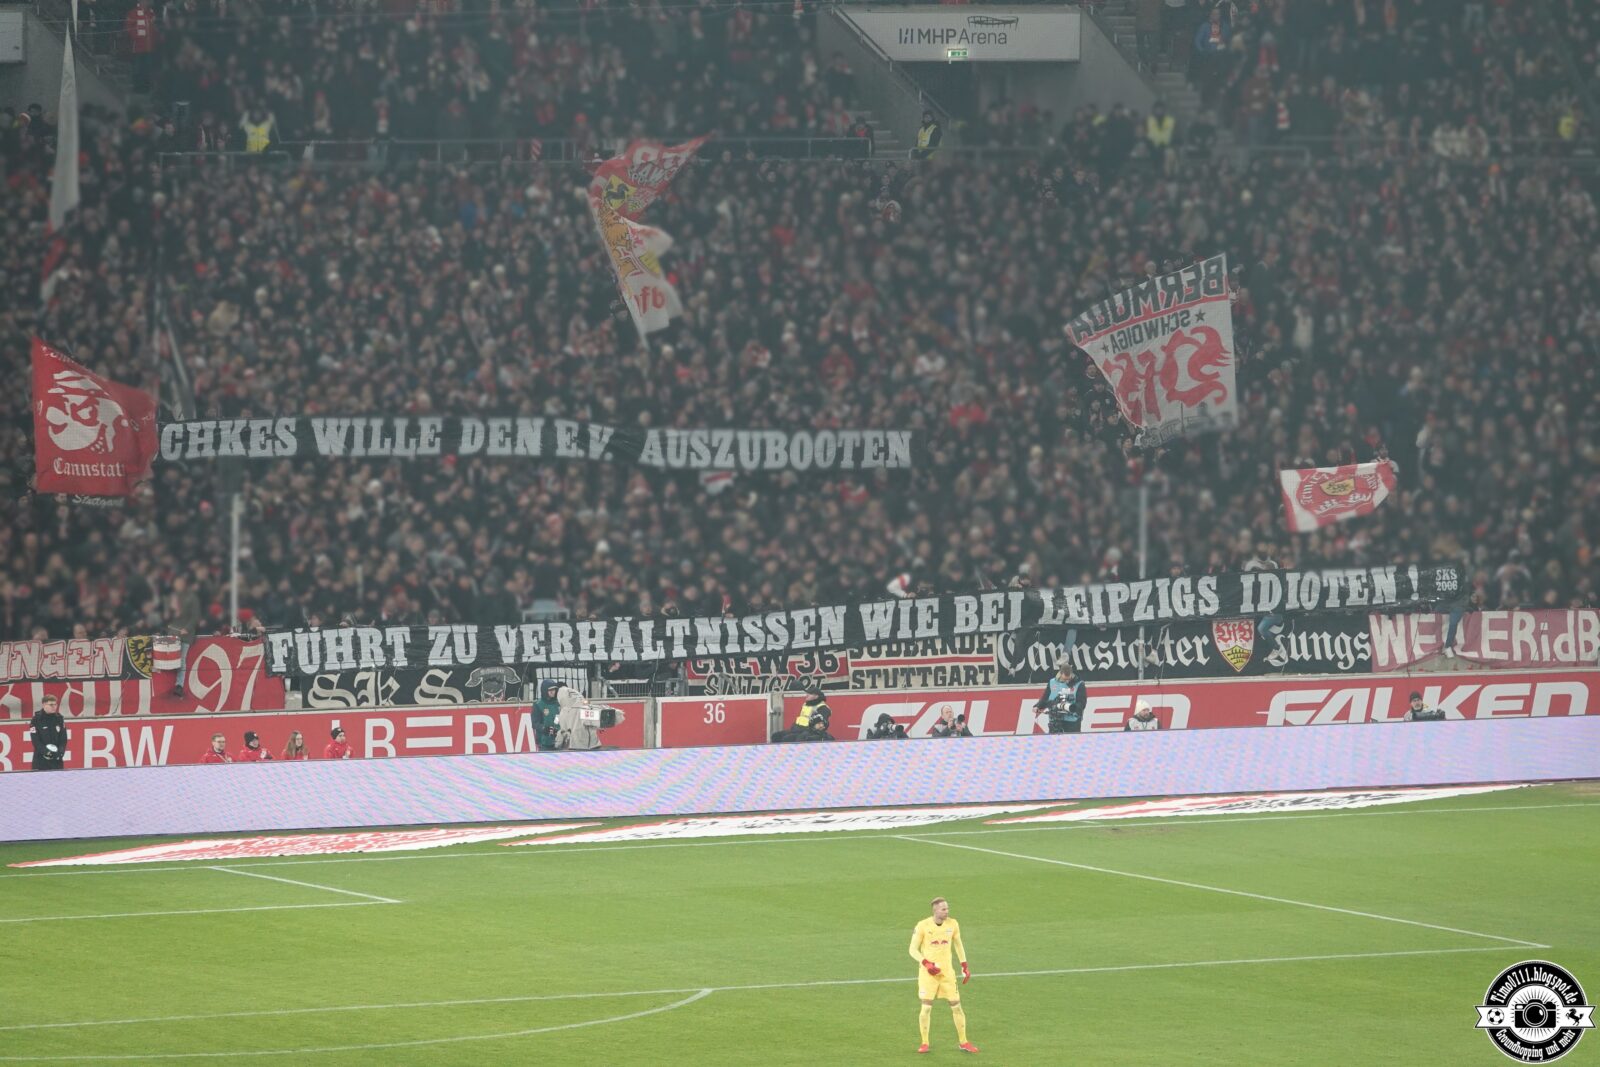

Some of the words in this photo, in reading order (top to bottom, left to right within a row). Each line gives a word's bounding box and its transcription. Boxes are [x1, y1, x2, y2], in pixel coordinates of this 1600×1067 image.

[311, 417, 443, 457] WILLE
[458, 417, 545, 457] DEN
[638, 429, 912, 470] AUSZUBOOTEN
[1435, 568, 1458, 581] SKS
[1435, 580, 1458, 592] 2006
[268, 626, 411, 675] FÜHRT
[428, 624, 478, 666] ZU
[494, 604, 848, 664] VERHÄLTNISSEN
[859, 598, 940, 641] WIE
[953, 591, 1025, 635] BEI
[1038, 575, 1220, 625] LEIPZIGS
[1240, 565, 1398, 613] IDIOTEN
[188, 643, 265, 713] 97
[851, 665, 995, 690] STUTTGART
[703, 702, 726, 724] 36
[1256, 681, 1590, 727] FALKEN
